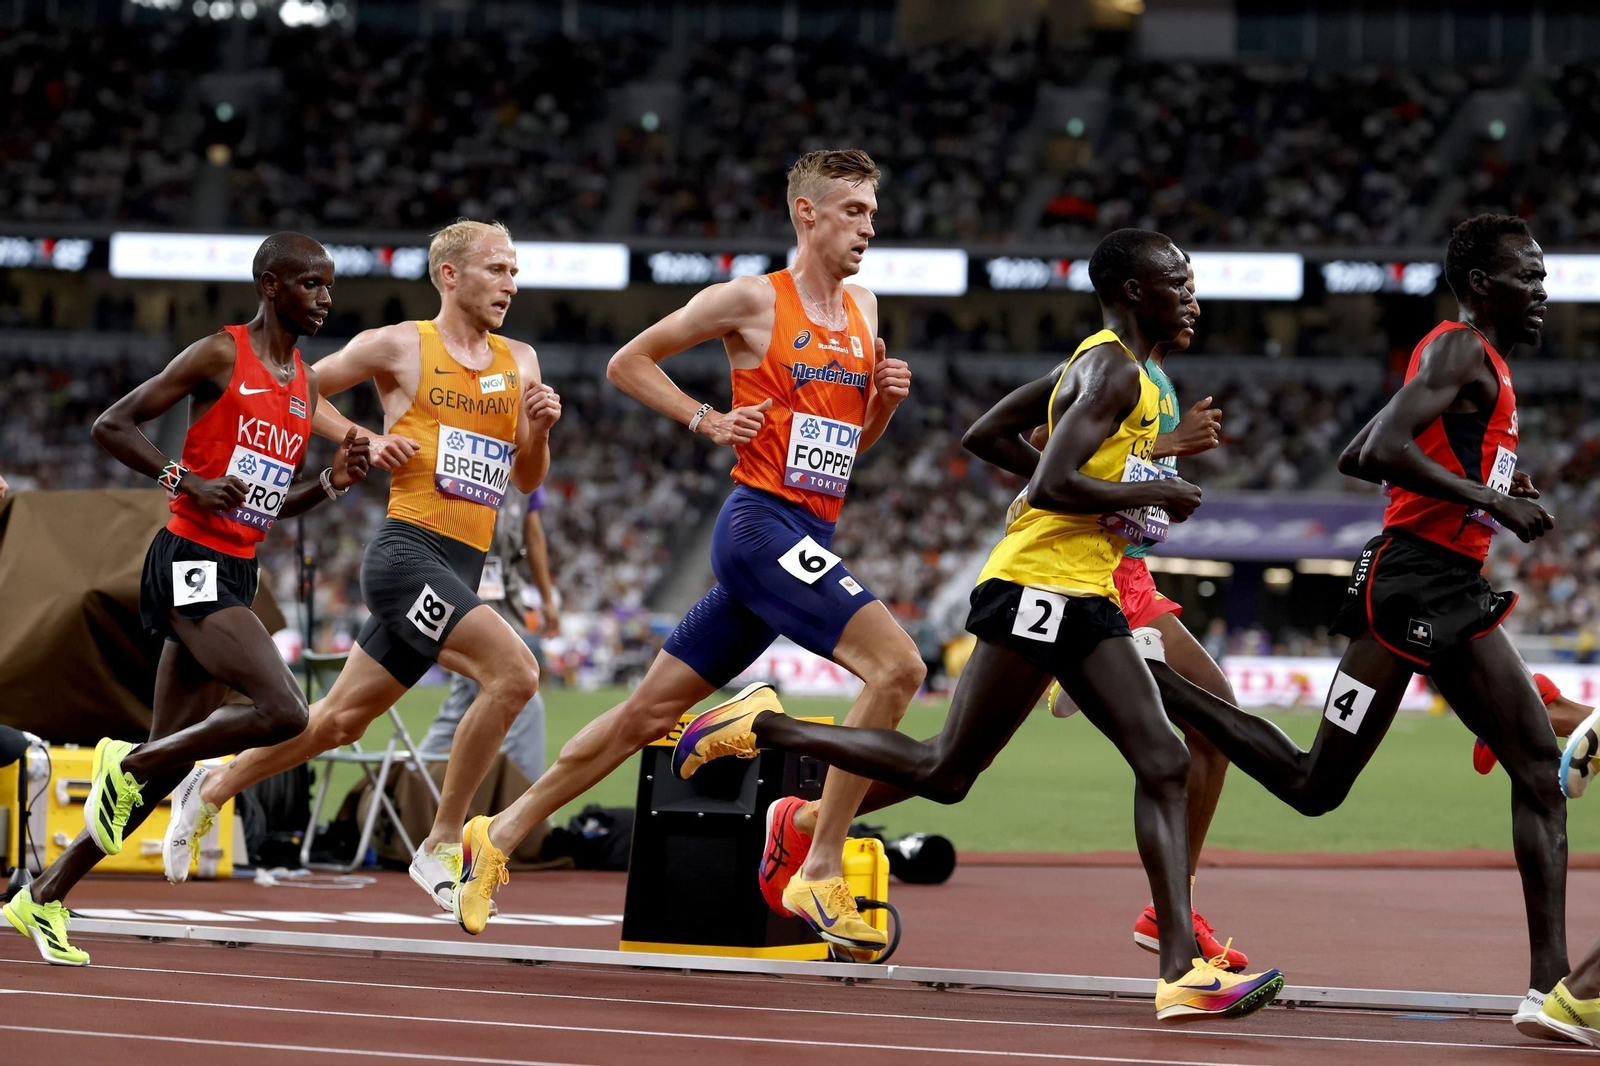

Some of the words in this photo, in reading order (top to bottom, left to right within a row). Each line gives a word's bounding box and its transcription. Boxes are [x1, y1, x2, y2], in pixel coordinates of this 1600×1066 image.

[480, 377, 504, 390] WGV
[429, 387, 517, 416] GERMANY
[465, 433, 517, 467] TDK
[820, 420, 862, 450] TDK
[258, 458, 294, 488] TD
[443, 453, 510, 492] BREMM
[798, 549, 827, 574] 6
[184, 567, 207, 599] 9
[414, 593, 446, 632] 18
[1027, 599, 1053, 635] 2
[1333, 688, 1359, 722] 4
